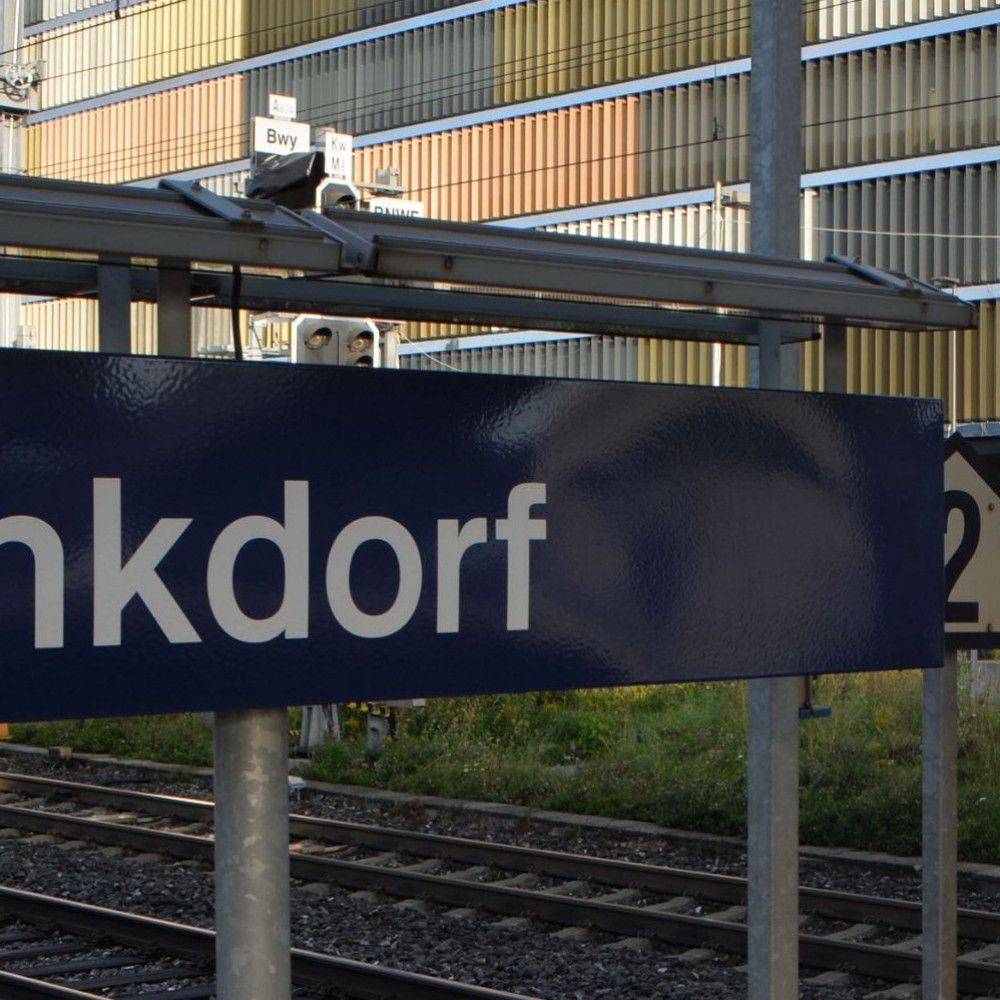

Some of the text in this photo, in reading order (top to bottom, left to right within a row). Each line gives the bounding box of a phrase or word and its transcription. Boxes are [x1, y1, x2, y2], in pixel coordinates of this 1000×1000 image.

[267, 128, 297, 151] Bwy
[331, 136, 347, 152] Kw
[0, 477, 547, 649] nkdorf
[944, 489, 981, 623] 2
